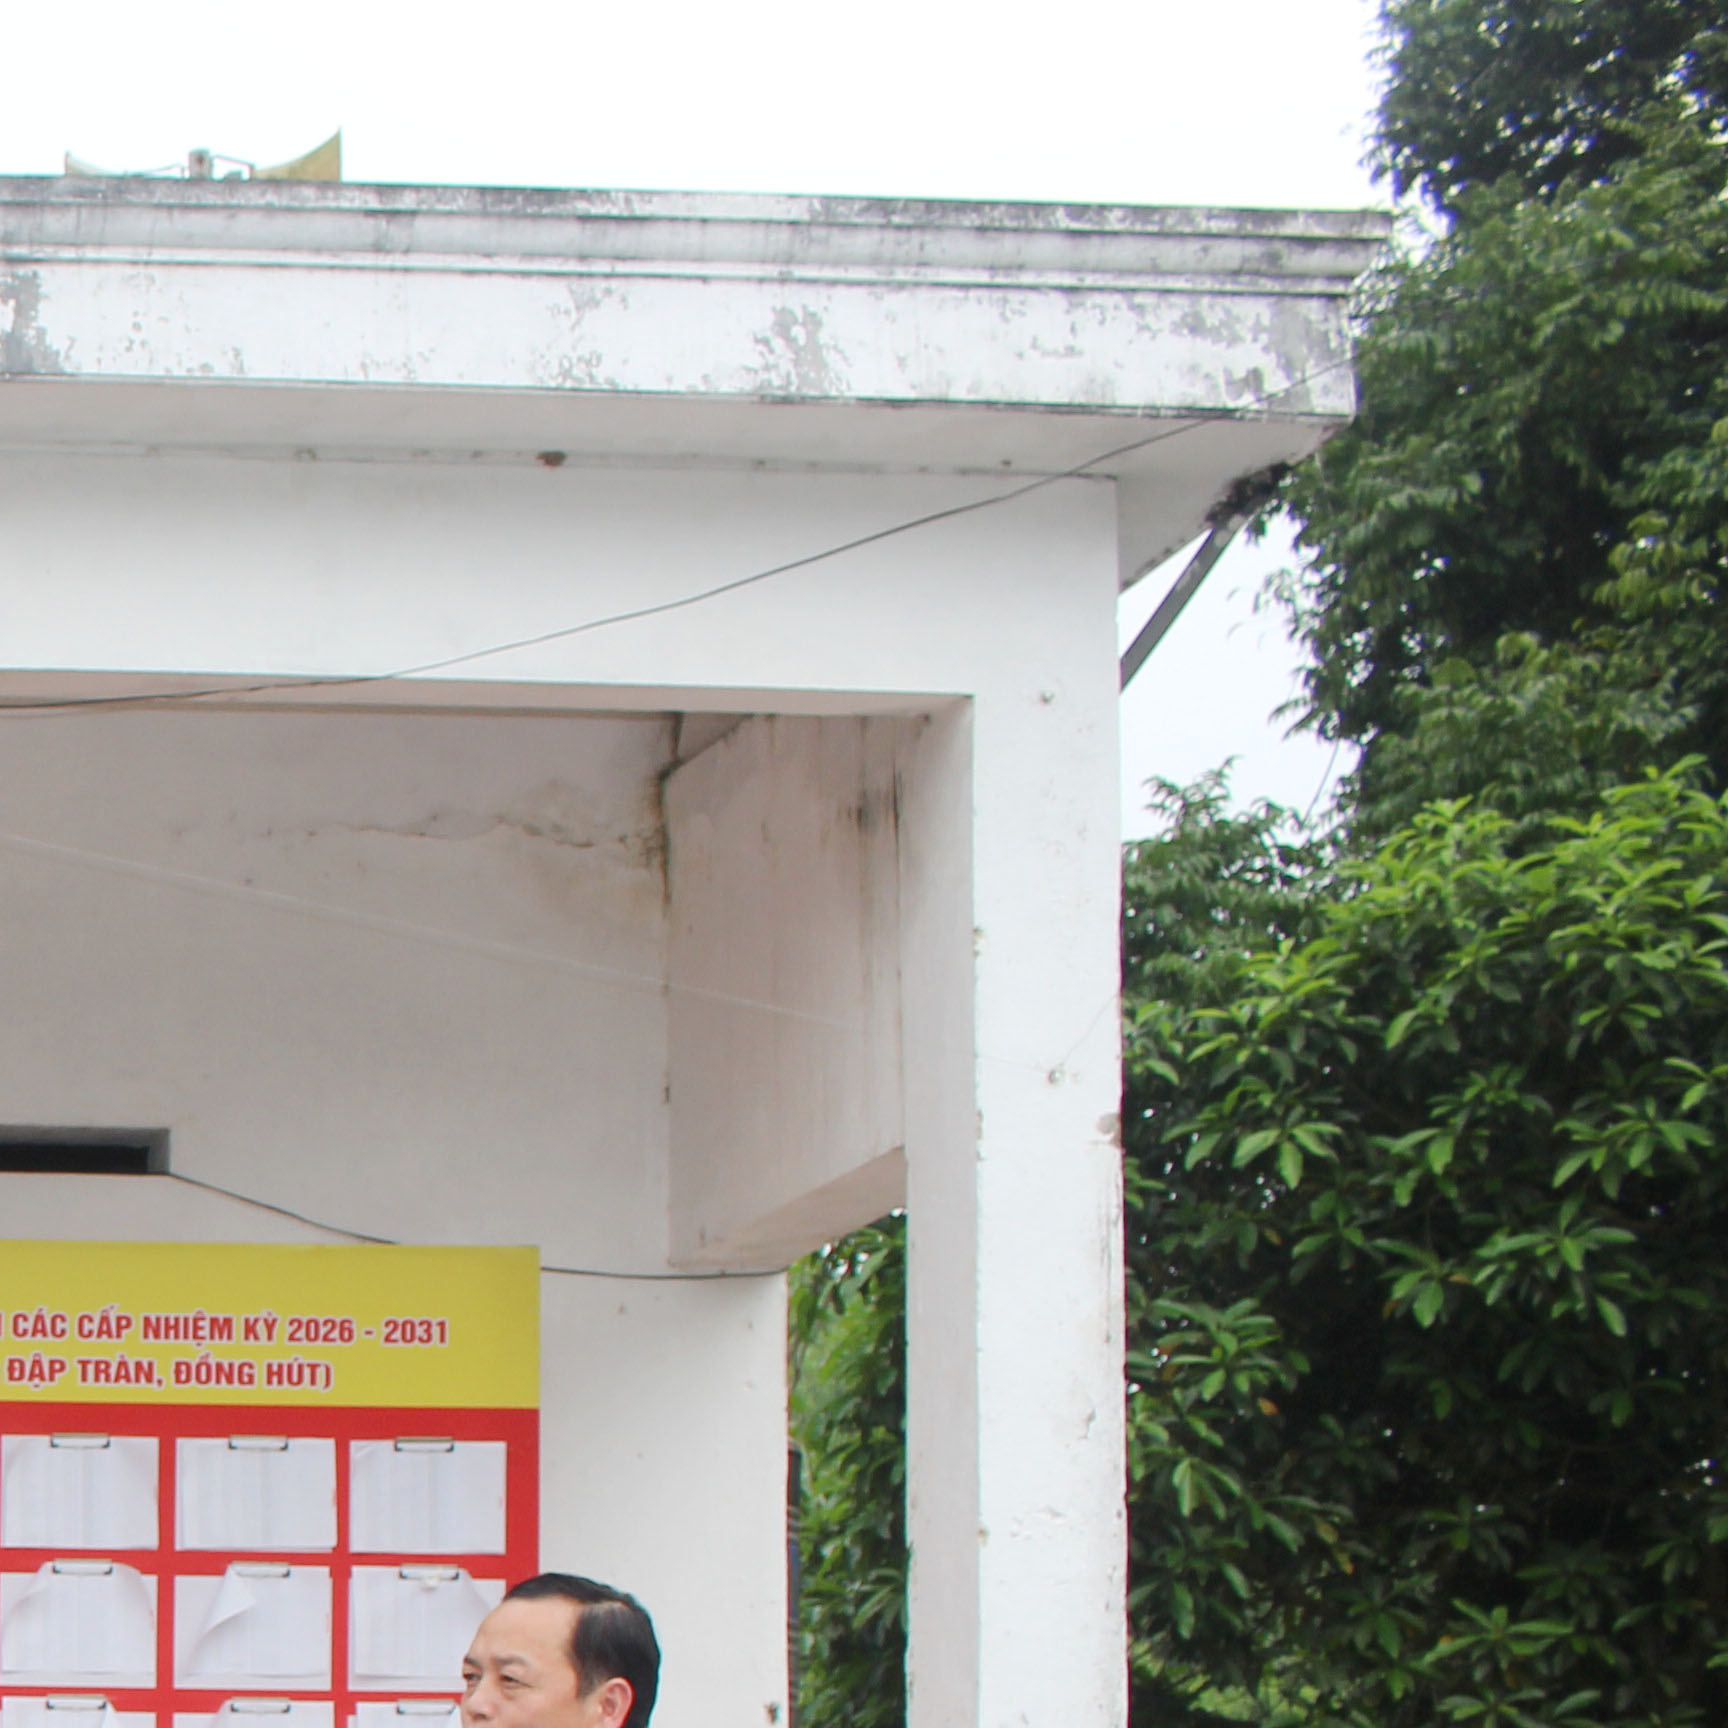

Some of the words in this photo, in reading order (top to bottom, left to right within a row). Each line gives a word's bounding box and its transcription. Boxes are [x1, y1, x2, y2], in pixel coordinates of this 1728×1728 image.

[12, 1306, 67, 1339] CÁC
[77, 1304, 132, 1340] CẤP
[143, 1310, 234, 1347] NHIỆM
[243, 1311, 279, 1342] KỲ
[287, 1317, 356, 1343] 2026
[383, 1318, 448, 1344] 2031
[8, 1353, 67, 1388] ĐẬP
[78, 1353, 165, 1388] TRÀN,
[266, 1356, 333, 1391] HÚT)
